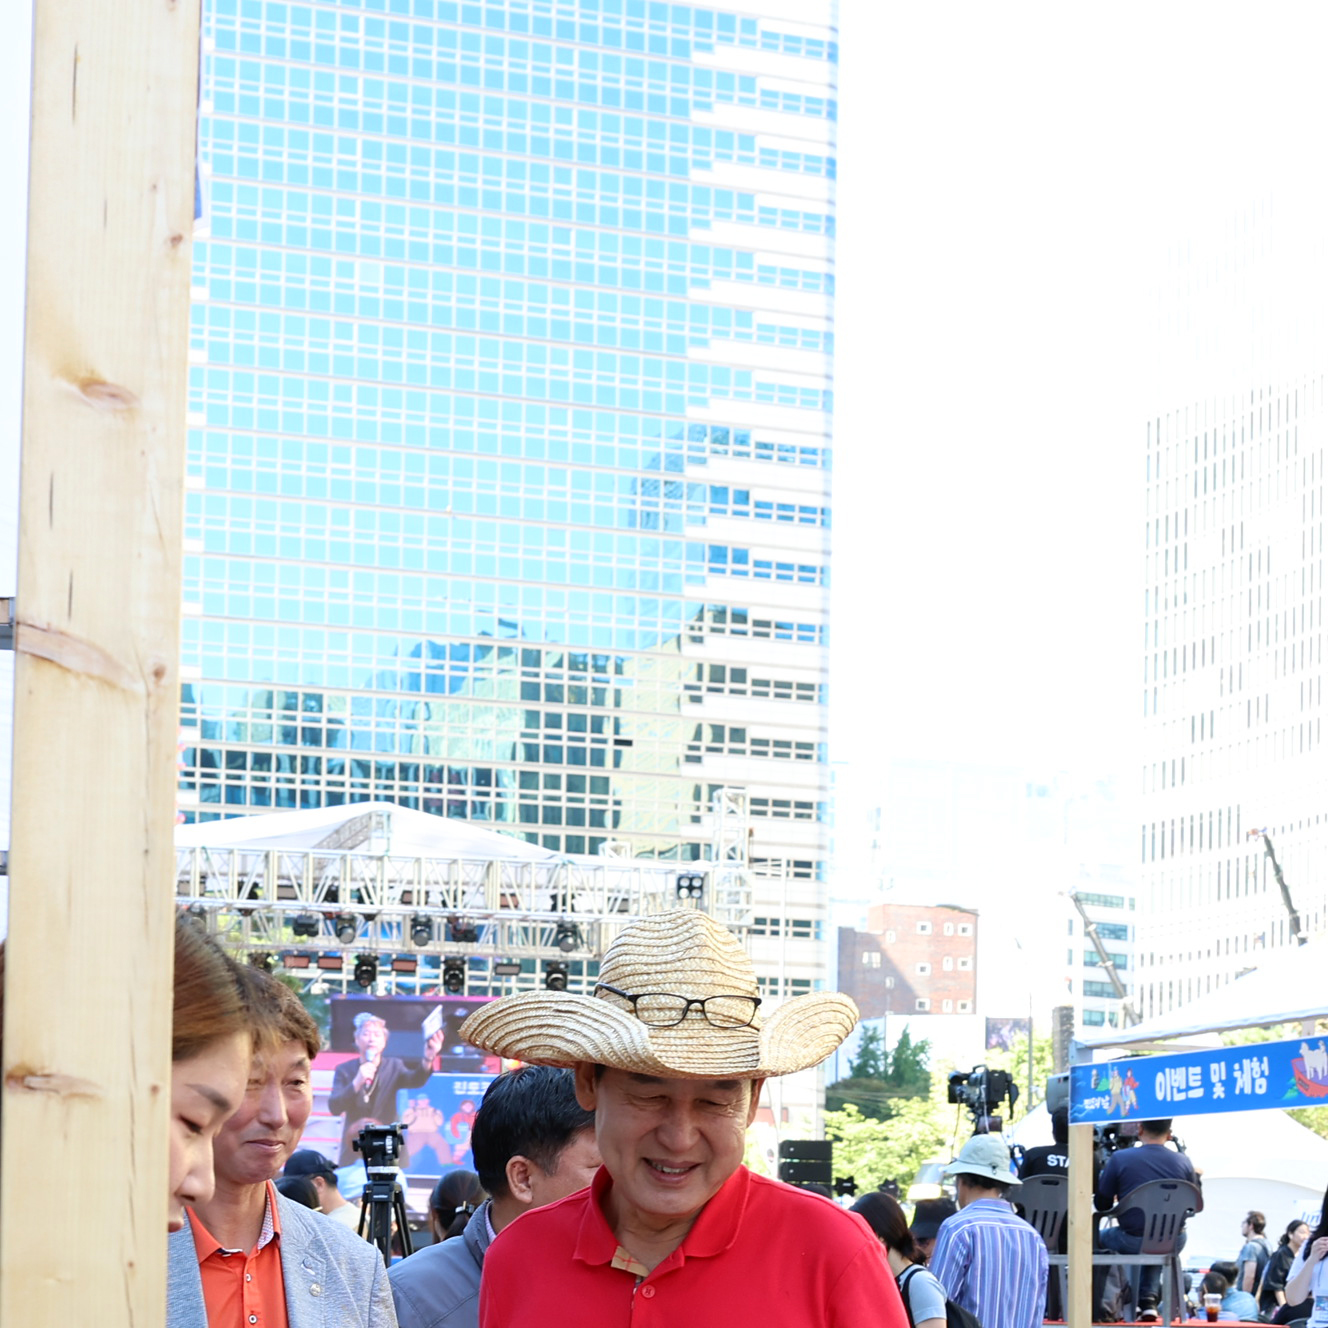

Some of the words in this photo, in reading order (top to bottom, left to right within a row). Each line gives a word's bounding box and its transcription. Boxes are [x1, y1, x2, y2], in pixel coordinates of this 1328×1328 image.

[1155, 1066, 1204, 1102] 이벤트
[1210, 1061, 1227, 1100] 및
[1233, 1056, 1270, 1095] 체험
